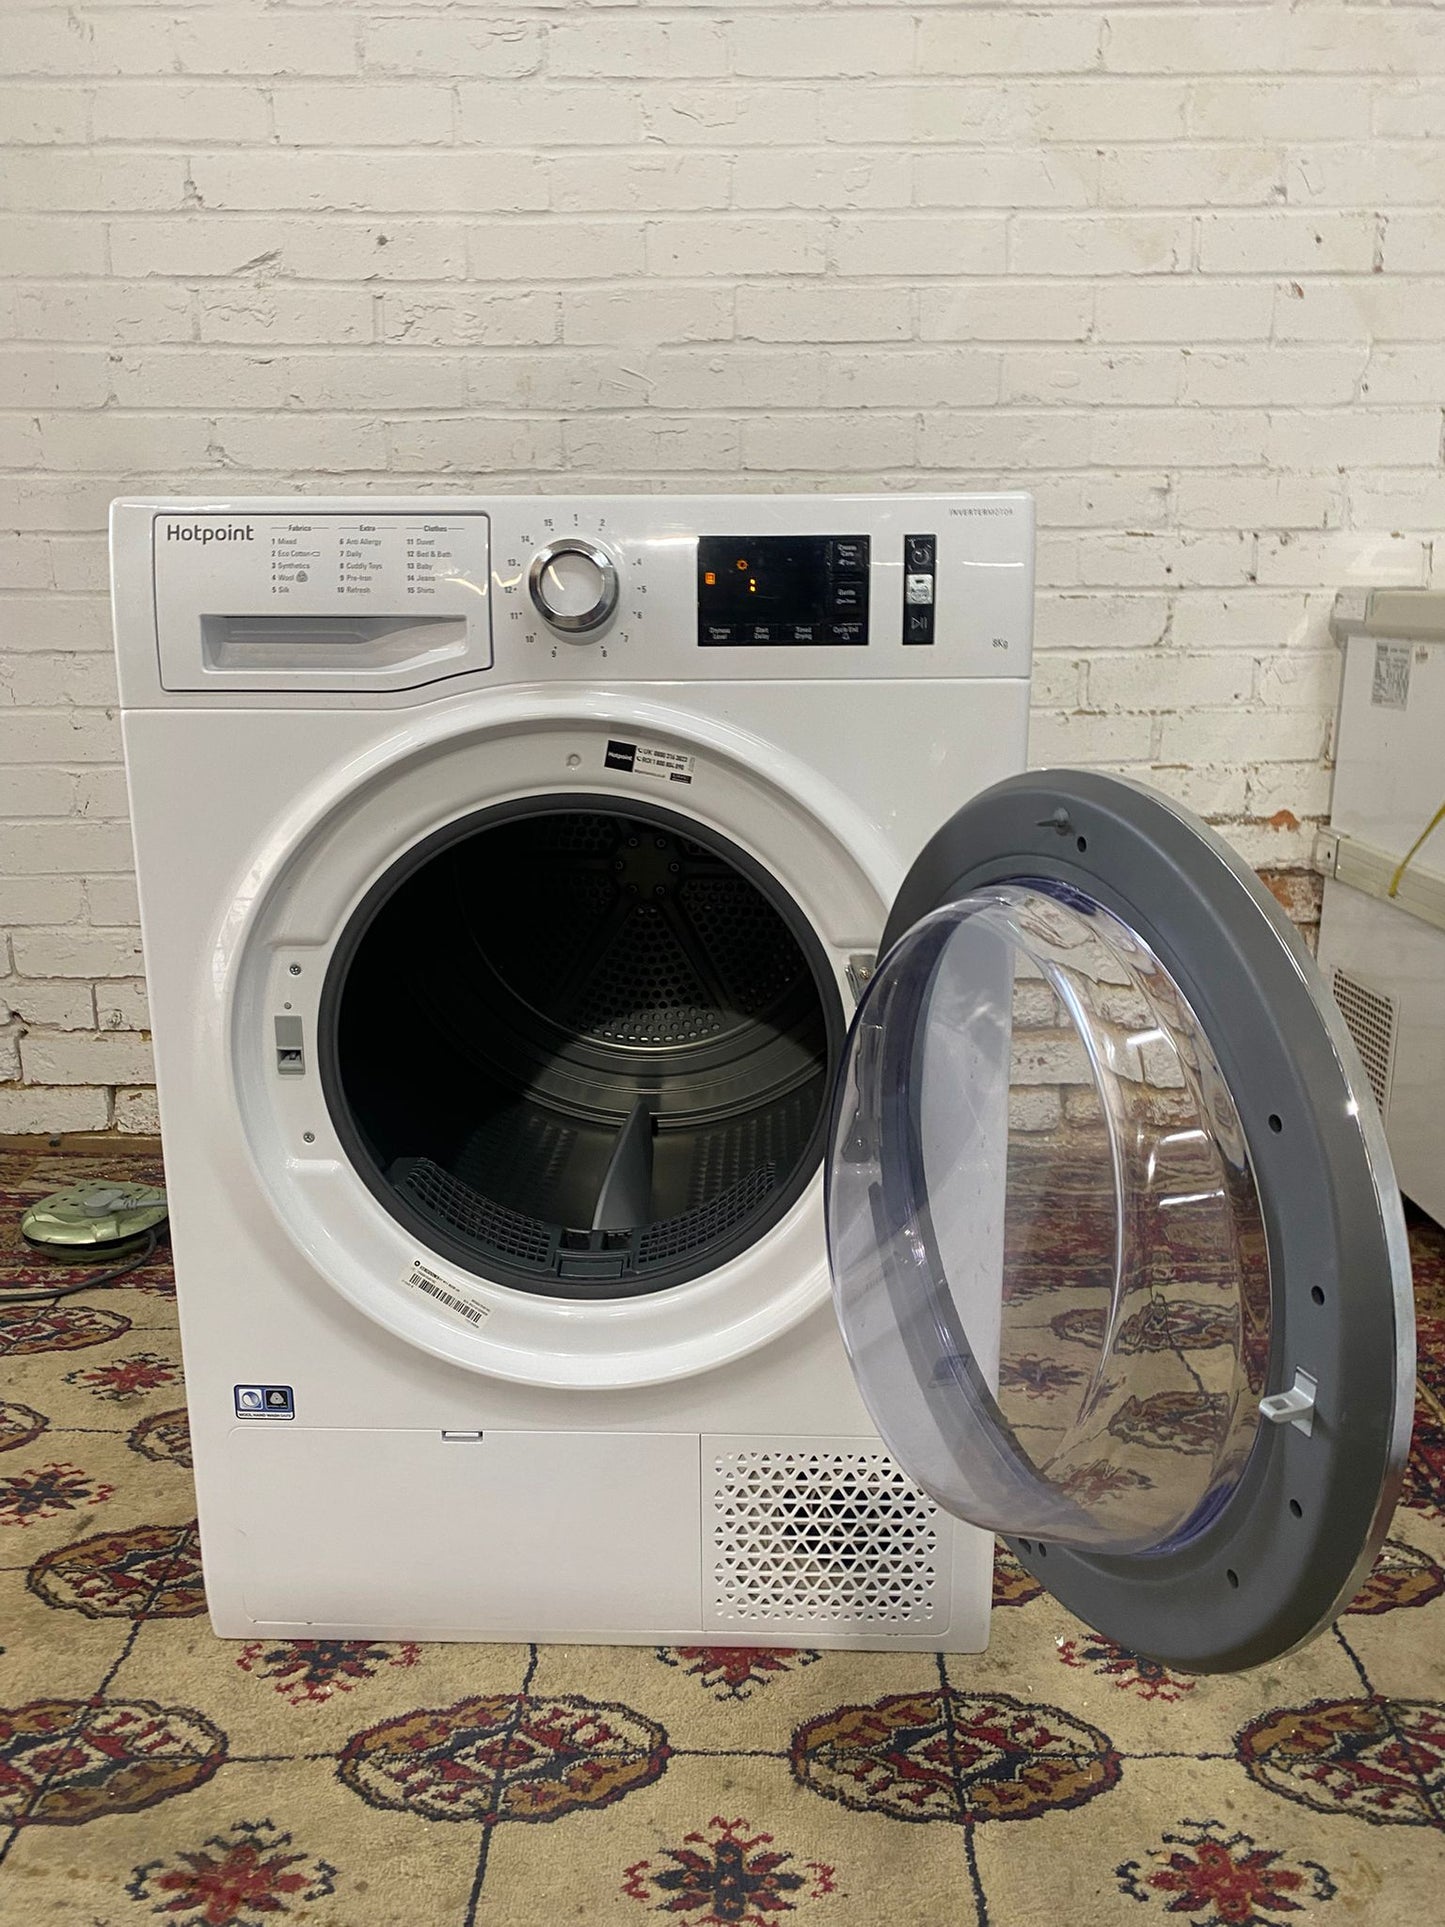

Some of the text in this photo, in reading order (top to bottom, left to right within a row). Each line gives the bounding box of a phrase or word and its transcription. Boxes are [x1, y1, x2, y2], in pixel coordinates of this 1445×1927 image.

[167, 524, 254, 544] Hotpoint
[346, 550, 362, 558] Daily
[278, 562, 310, 570] Synthetics
